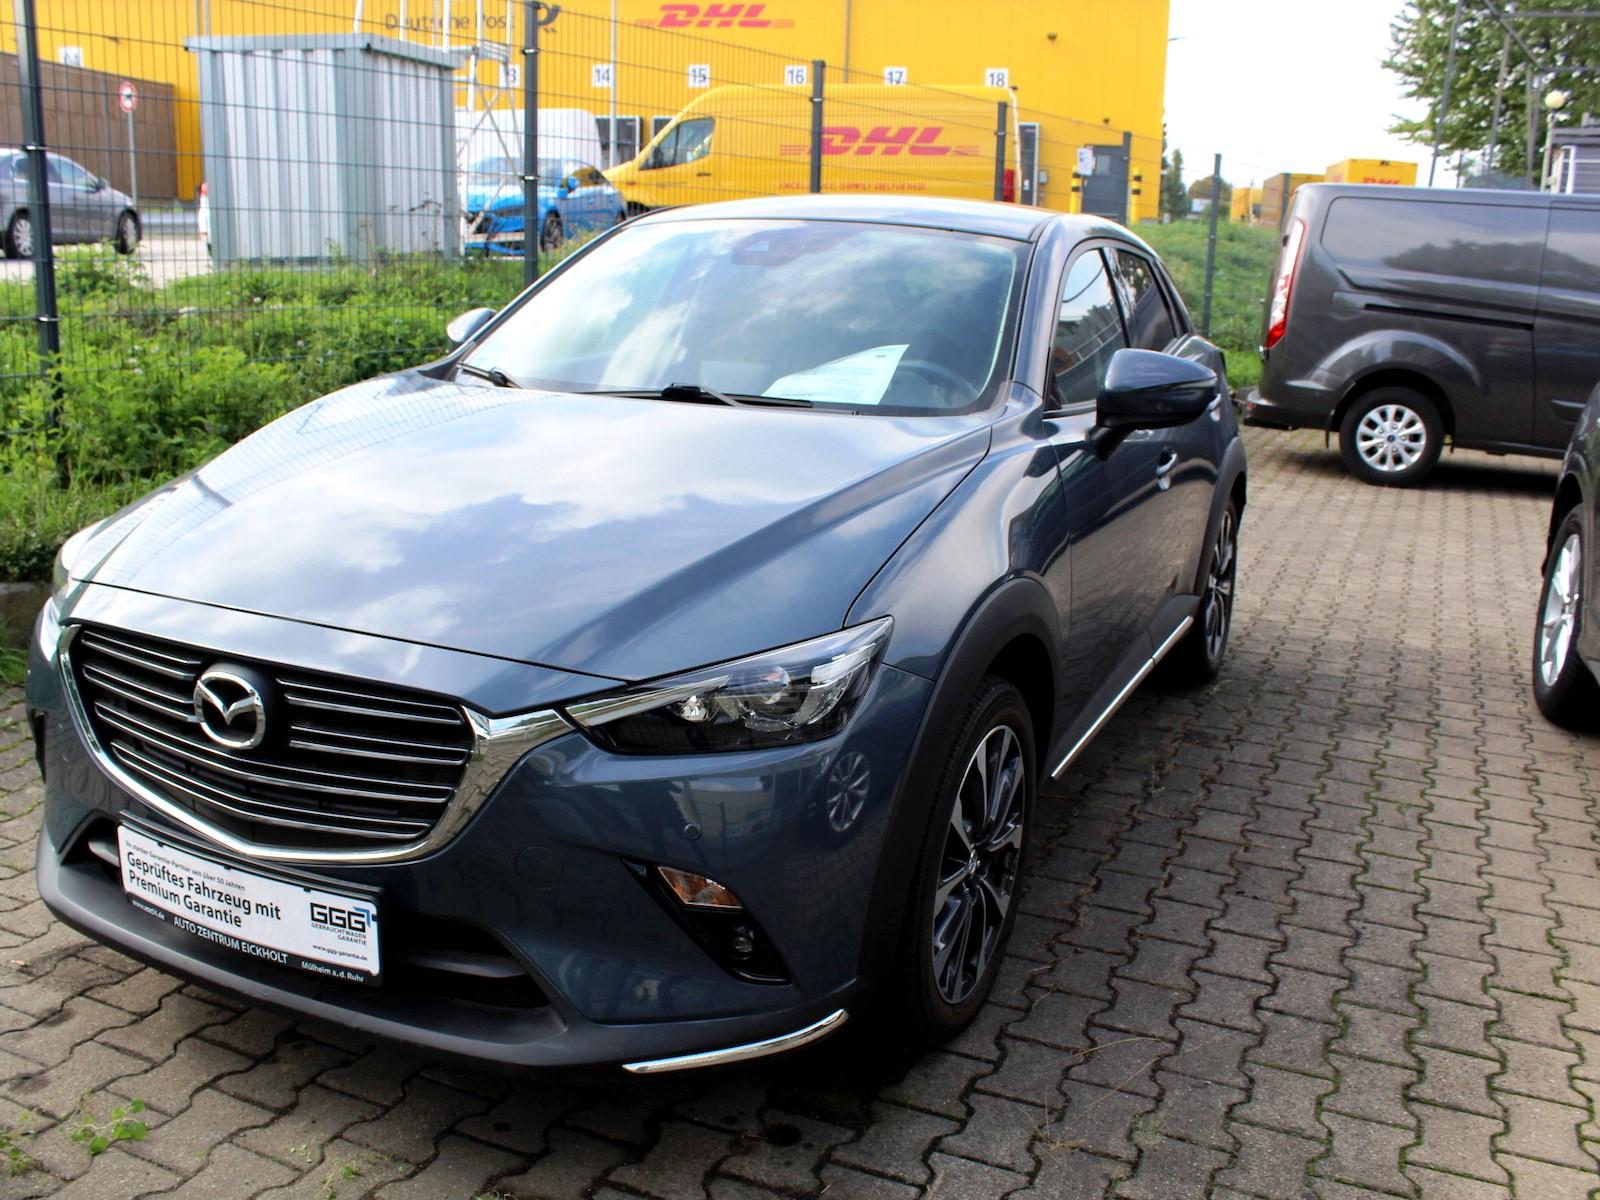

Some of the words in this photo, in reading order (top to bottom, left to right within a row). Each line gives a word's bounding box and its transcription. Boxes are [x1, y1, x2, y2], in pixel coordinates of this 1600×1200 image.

[385, 14, 470, 31] Dutche
[657, 4, 772, 28] DHL
[594, 68, 611, 82] 14
[690, 68, 707, 83] 15
[787, 69, 805, 84] 16
[887, 70, 904, 84] 17
[988, 72, 1006, 87] 18
[813, 126, 952, 156] DHL
[127, 851, 185, 889] Geprüftes
[187, 876, 251, 915] Fahrzeug
[255, 901, 282, 921] mit
[129, 869, 181, 906] Premium
[183, 894, 242, 928] Garantie
[310, 902, 367, 933] GGG
[311, 922, 367, 940] GEBRAUCHTWAGEN
[337, 934, 367, 946] GARANTIE
[173, 916, 197, 934] AUTO
[197, 925, 240, 950] ZENTRUM
[242, 942, 289, 965] EICKHOLT
[301, 960, 331, 975] Mülheim
[347, 971, 364, 983] Ruhr
